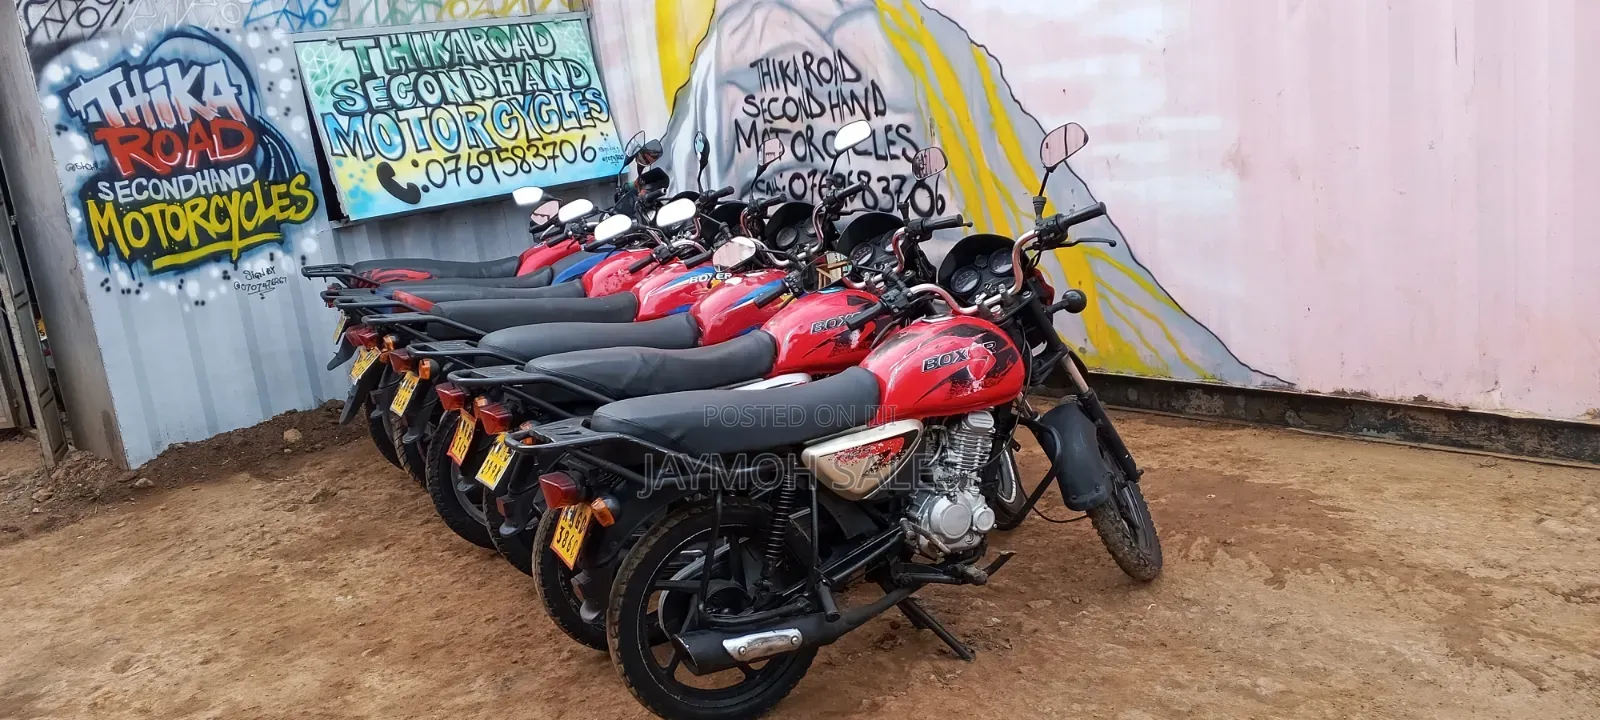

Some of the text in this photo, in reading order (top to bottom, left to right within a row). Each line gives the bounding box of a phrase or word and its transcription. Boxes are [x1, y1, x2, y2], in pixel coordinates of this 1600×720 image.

[750, 49, 862, 94] THIKA ROAD
[321, 87, 611, 161] MOTORCYCLES
[742, 79, 887, 124] SECOND HAND
[95, 117, 256, 177] ROAD
[97, 163, 256, 203] SECONDHAND
[86, 174, 315, 260] MOTORCYCLES
[811, 311, 860, 334] BOX
[922, 341, 997, 372] BOXR
